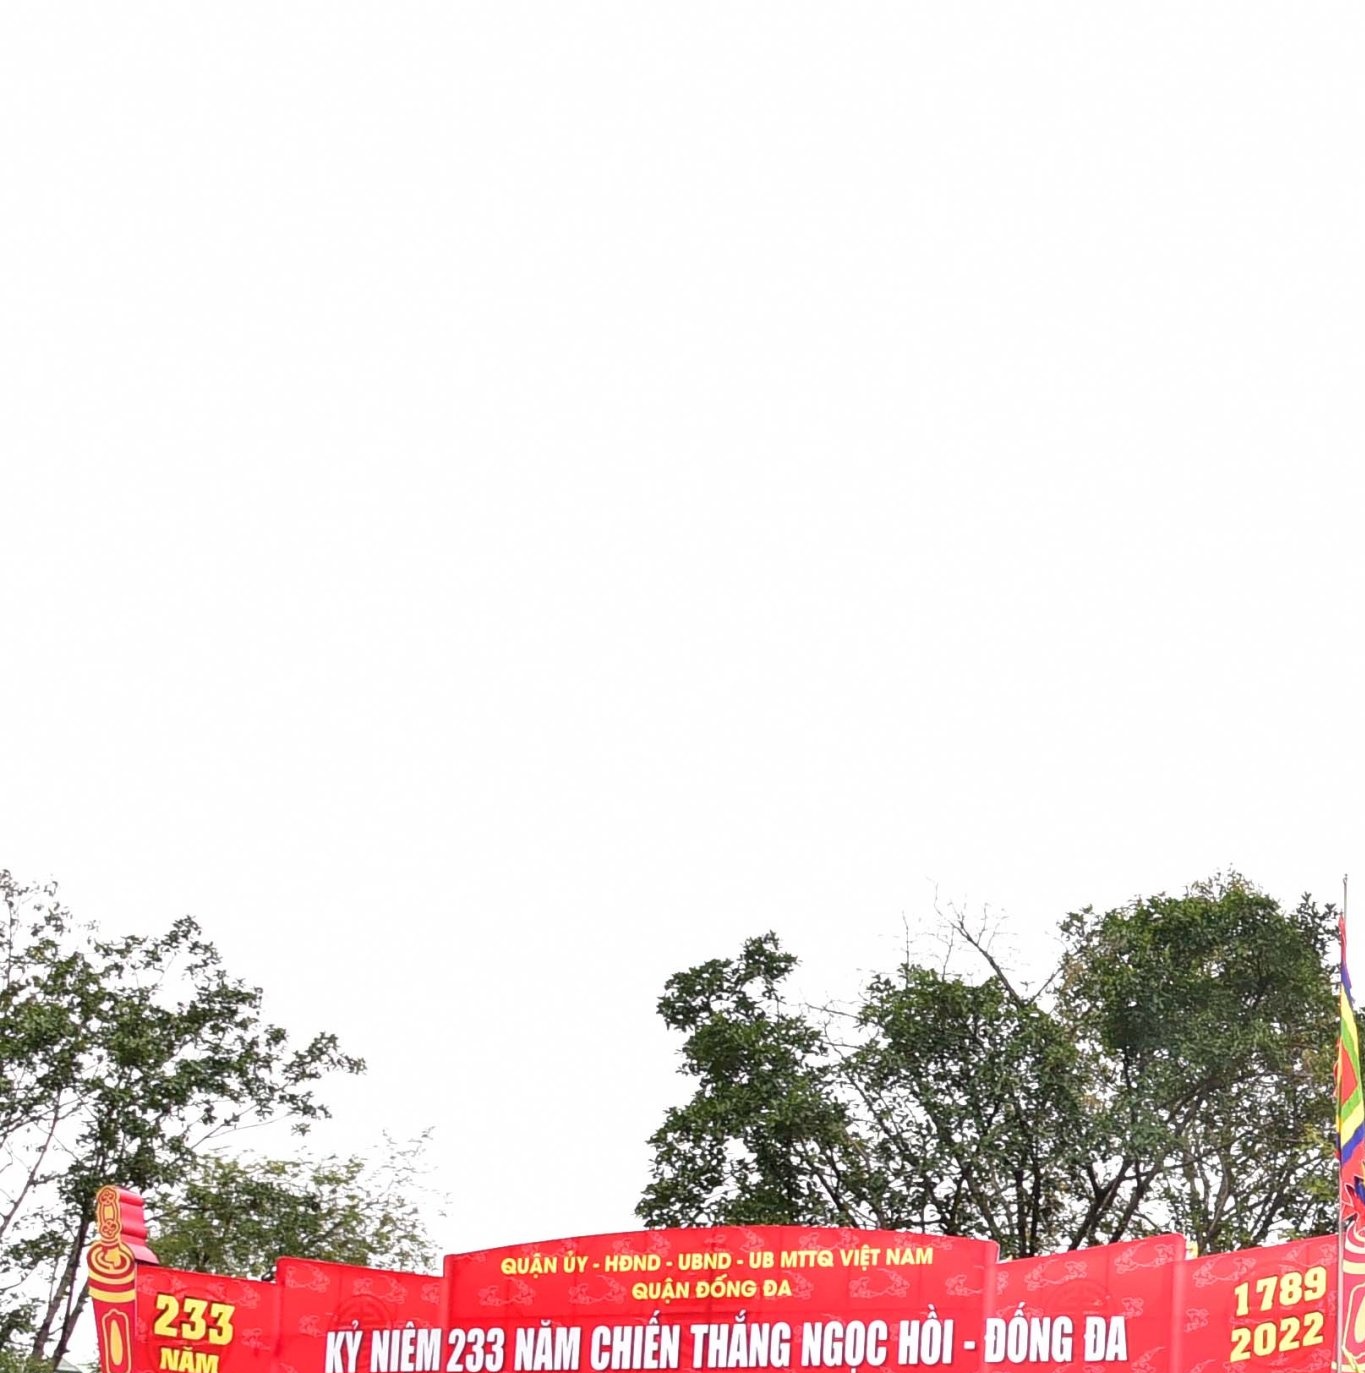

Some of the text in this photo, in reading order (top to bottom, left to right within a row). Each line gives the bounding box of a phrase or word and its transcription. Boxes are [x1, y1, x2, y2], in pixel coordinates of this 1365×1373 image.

[501, 1252, 558, 1279] QUẬN
[563, 1250, 588, 1273] ỦY
[605, 1254, 661, 1272] HĐND
[678, 1252, 732, 1271] UBND
[749, 1251, 775, 1269] UB
[780, 1249, 834, 1268] MTTQ
[839, 1244, 881, 1272] VIỆT
[885, 1247, 934, 1266] NAM
[632, 1275, 792, 1305] QUẬN ĐỐNG ĐA
[1234, 1267, 1327, 1316] 1789
[154, 1294, 235, 1346] 233
[325, 1321, 363, 1373] KỶ
[446, 1328, 505, 1373] 233
[514, 1318, 581, 1371] NĂM
[590, 1309, 680, 1371] CHIẾN
[690, 1308, 791, 1369] THẮNG
[898, 1304, 954, 1366] HỒI
[984, 1301, 1073, 1364] ĐỐNG
[1083, 1315, 1128, 1362] ĐA
[1230, 1311, 1325, 1364] 2022
